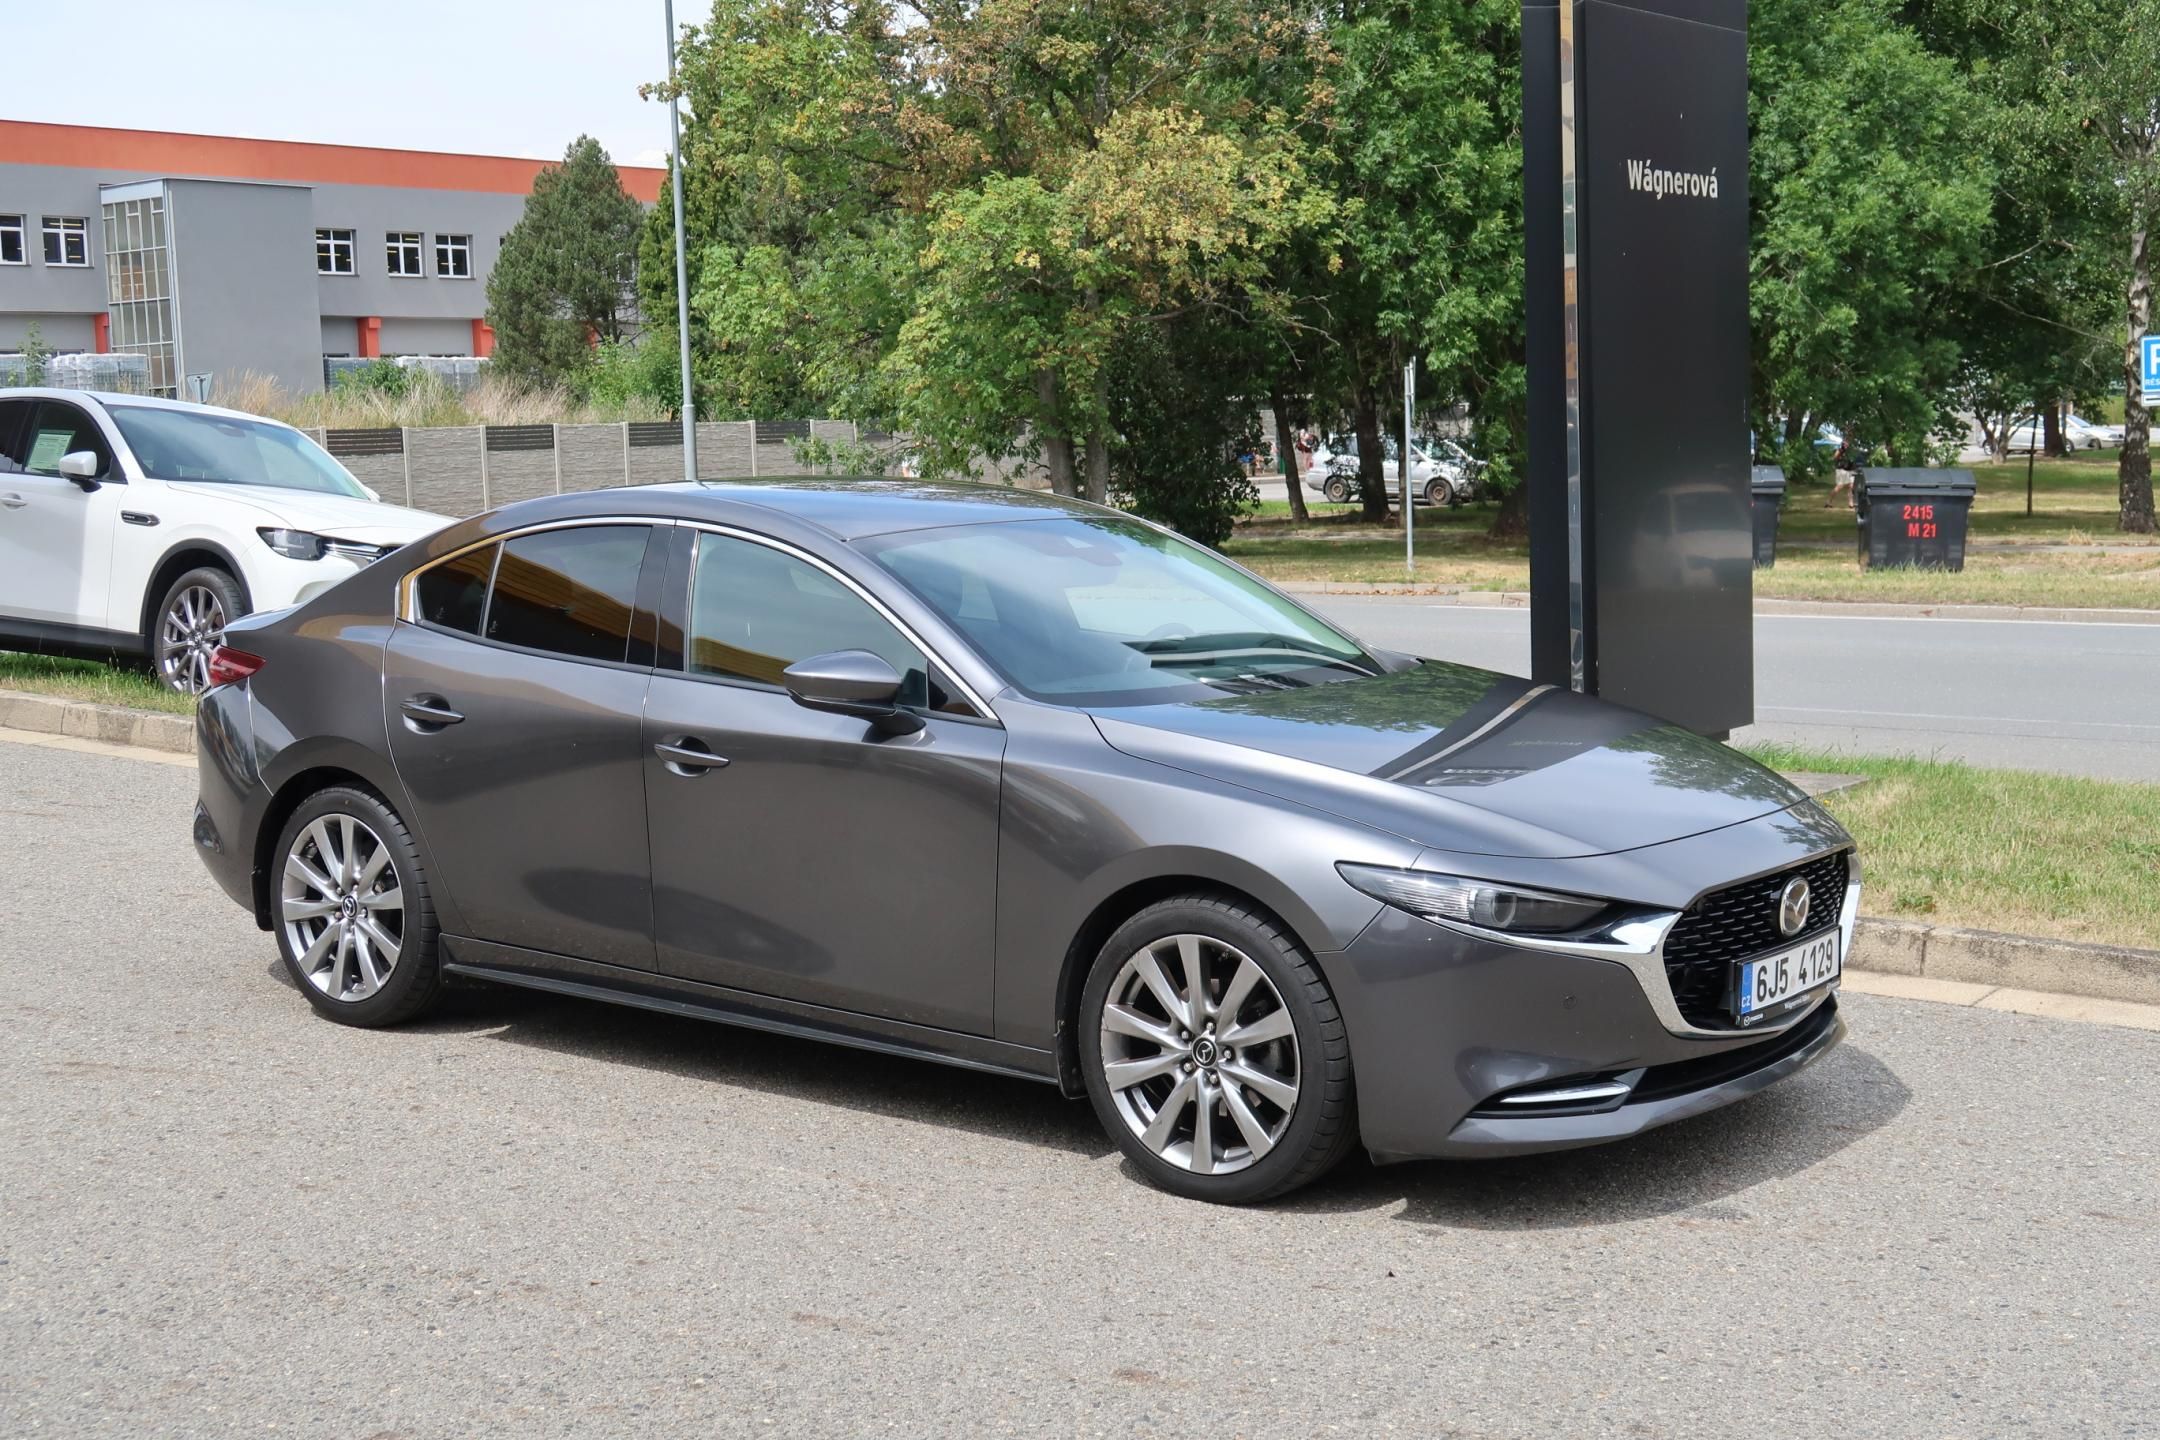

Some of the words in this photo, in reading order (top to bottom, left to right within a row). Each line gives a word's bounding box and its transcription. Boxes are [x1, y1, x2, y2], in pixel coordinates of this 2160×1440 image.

[1627, 159, 1718, 200] Wágnerová
[1903, 505, 1934, 519] 2415
[1908, 523, 1919, 537] M
[1922, 523, 1937, 538] 21
[1757, 957, 1789, 1003] 6J5
[1799, 938, 1833, 984] 4129
[1741, 995, 1751, 1007] CZ
